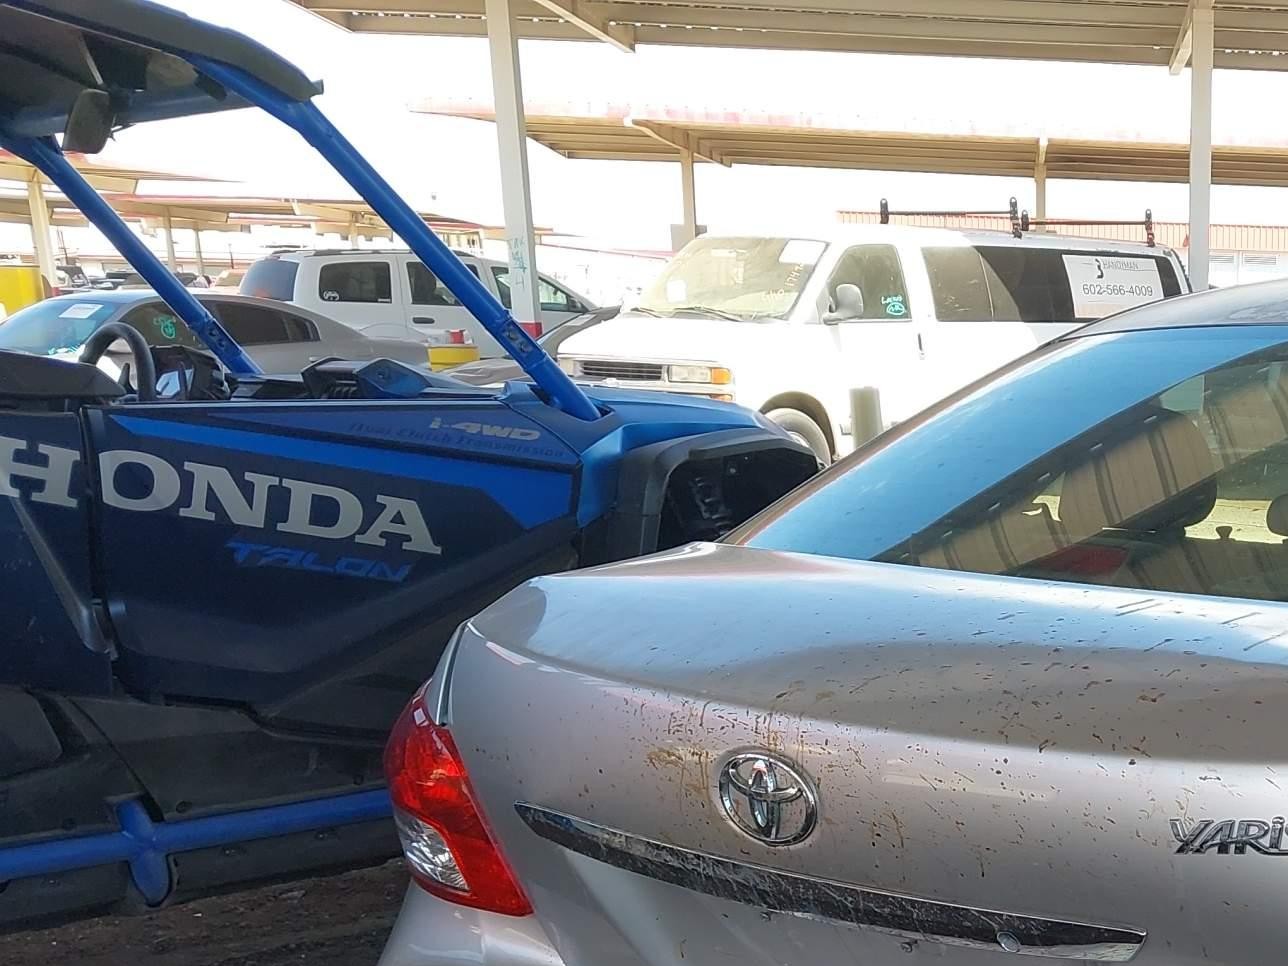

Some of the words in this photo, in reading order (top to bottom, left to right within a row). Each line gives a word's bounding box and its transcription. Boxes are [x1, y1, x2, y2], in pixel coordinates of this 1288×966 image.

[1082, 283, 1153, 297] 602-566-4009
[0, 435, 442, 555] HONDA
[224, 540, 415, 583] TALON
